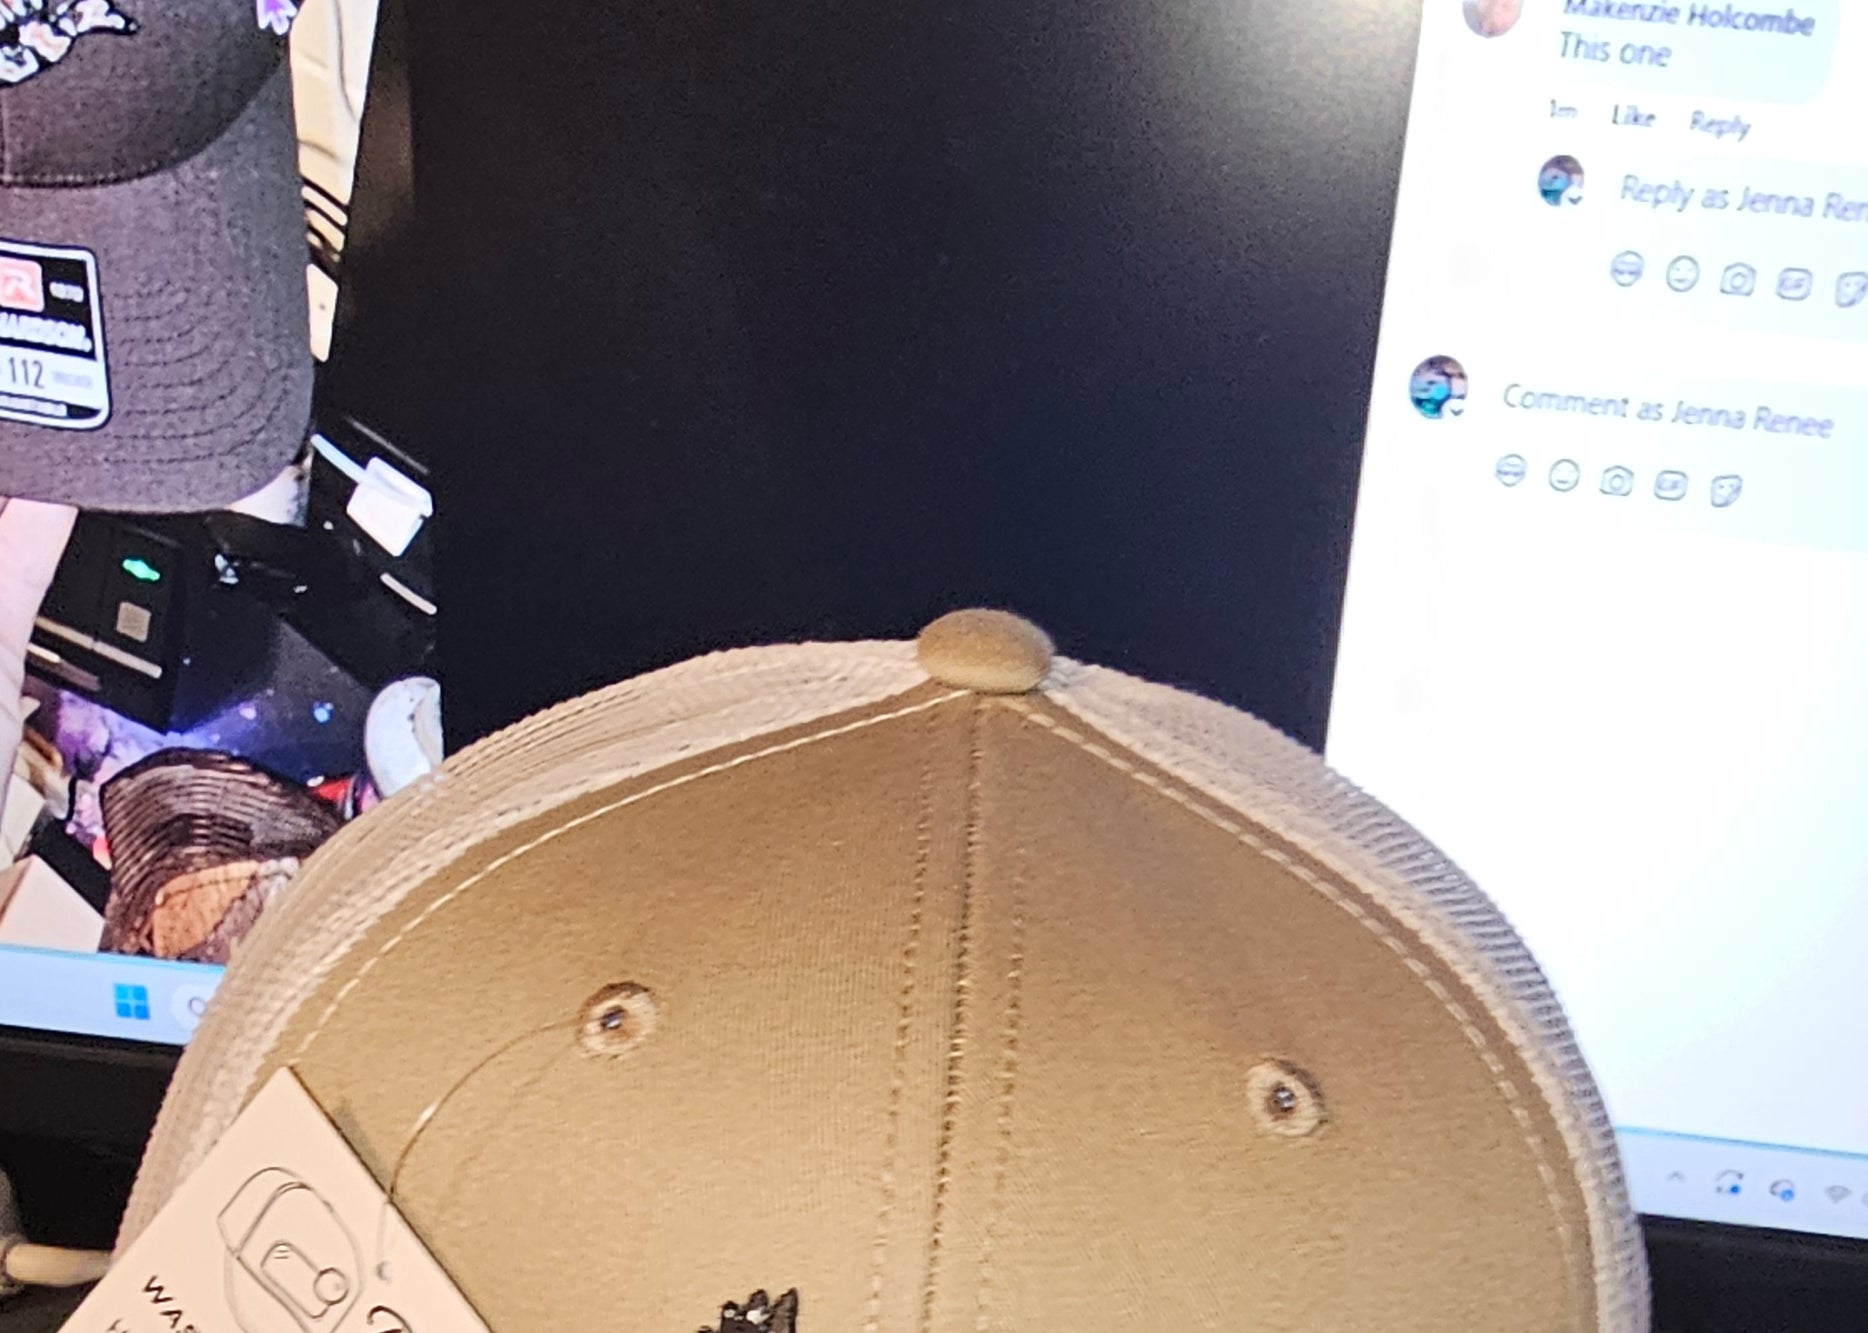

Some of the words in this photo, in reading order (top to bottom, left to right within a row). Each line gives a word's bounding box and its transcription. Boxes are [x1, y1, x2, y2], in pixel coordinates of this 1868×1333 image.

[1688, 2, 1816, 37] Holcombe
[1561, 31, 1611, 62] This
[1619, 43, 1673, 68] one
[1612, 104, 1657, 128] Like
[1690, 110, 1752, 143] Reply
[1620, 174, 1696, 213] Reply
[1701, 188, 1730, 210] as
[1738, 186, 1814, 217] Jenna
[8, 356, 45, 390] 112
[1504, 383, 1630, 418] Comment
[1636, 401, 1664, 422] as
[1671, 401, 1747, 430] Jenna
[1753, 406, 1836, 440] Renee
